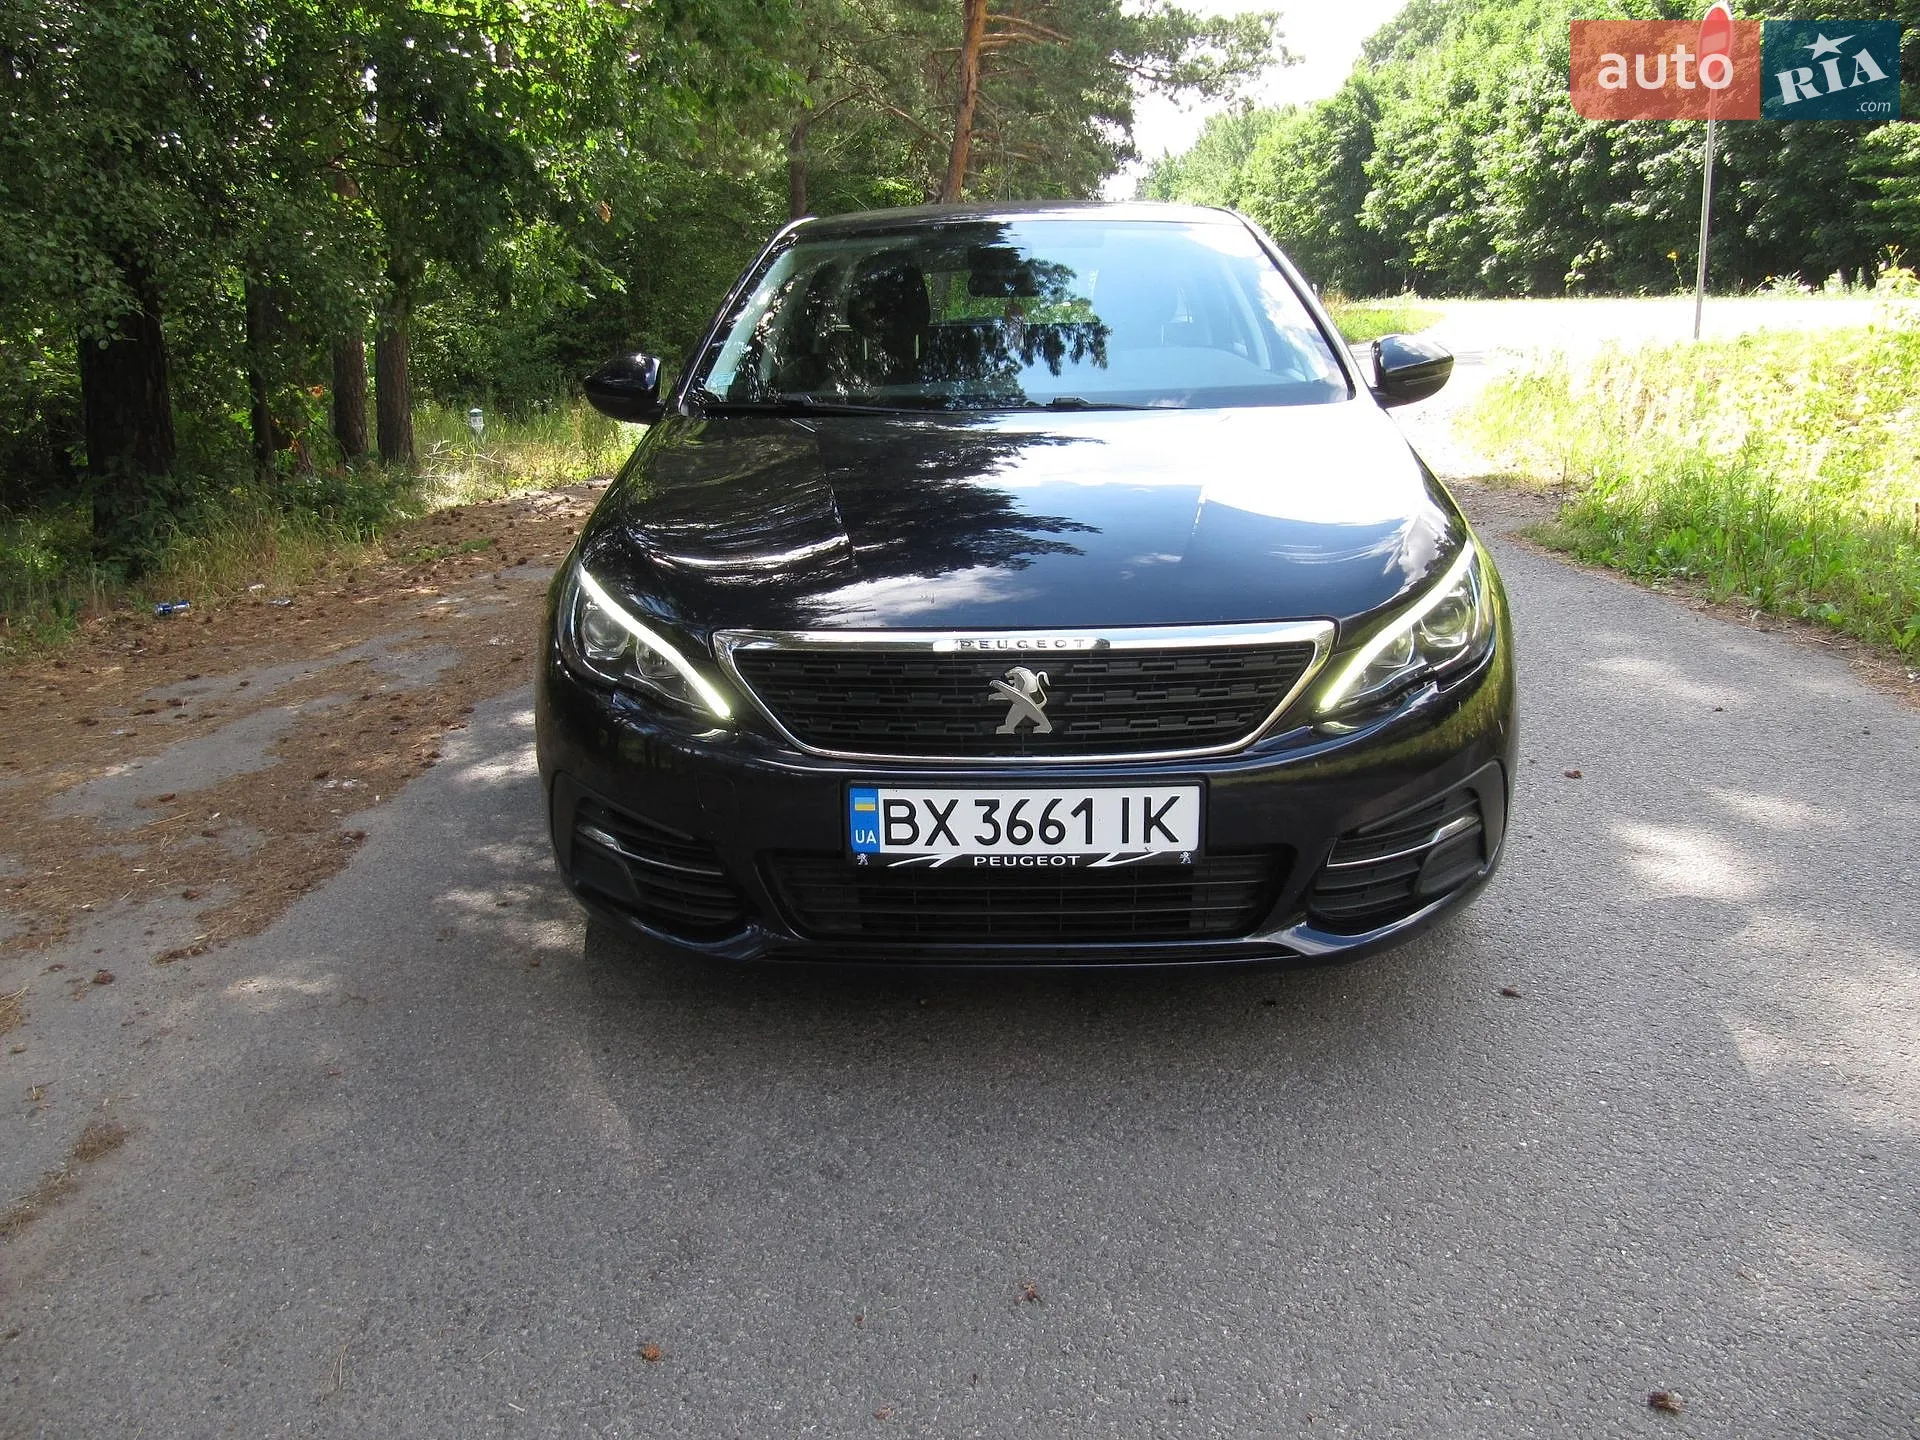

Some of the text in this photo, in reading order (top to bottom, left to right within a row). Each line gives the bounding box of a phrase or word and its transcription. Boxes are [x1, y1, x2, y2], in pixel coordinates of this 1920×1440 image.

[958, 639, 1085, 650] PEUGEOT
[882, 795, 1181, 847] BX 3661 IK
[855, 830, 877, 845] UA
[972, 855, 1081, 867] PEUGEOT
